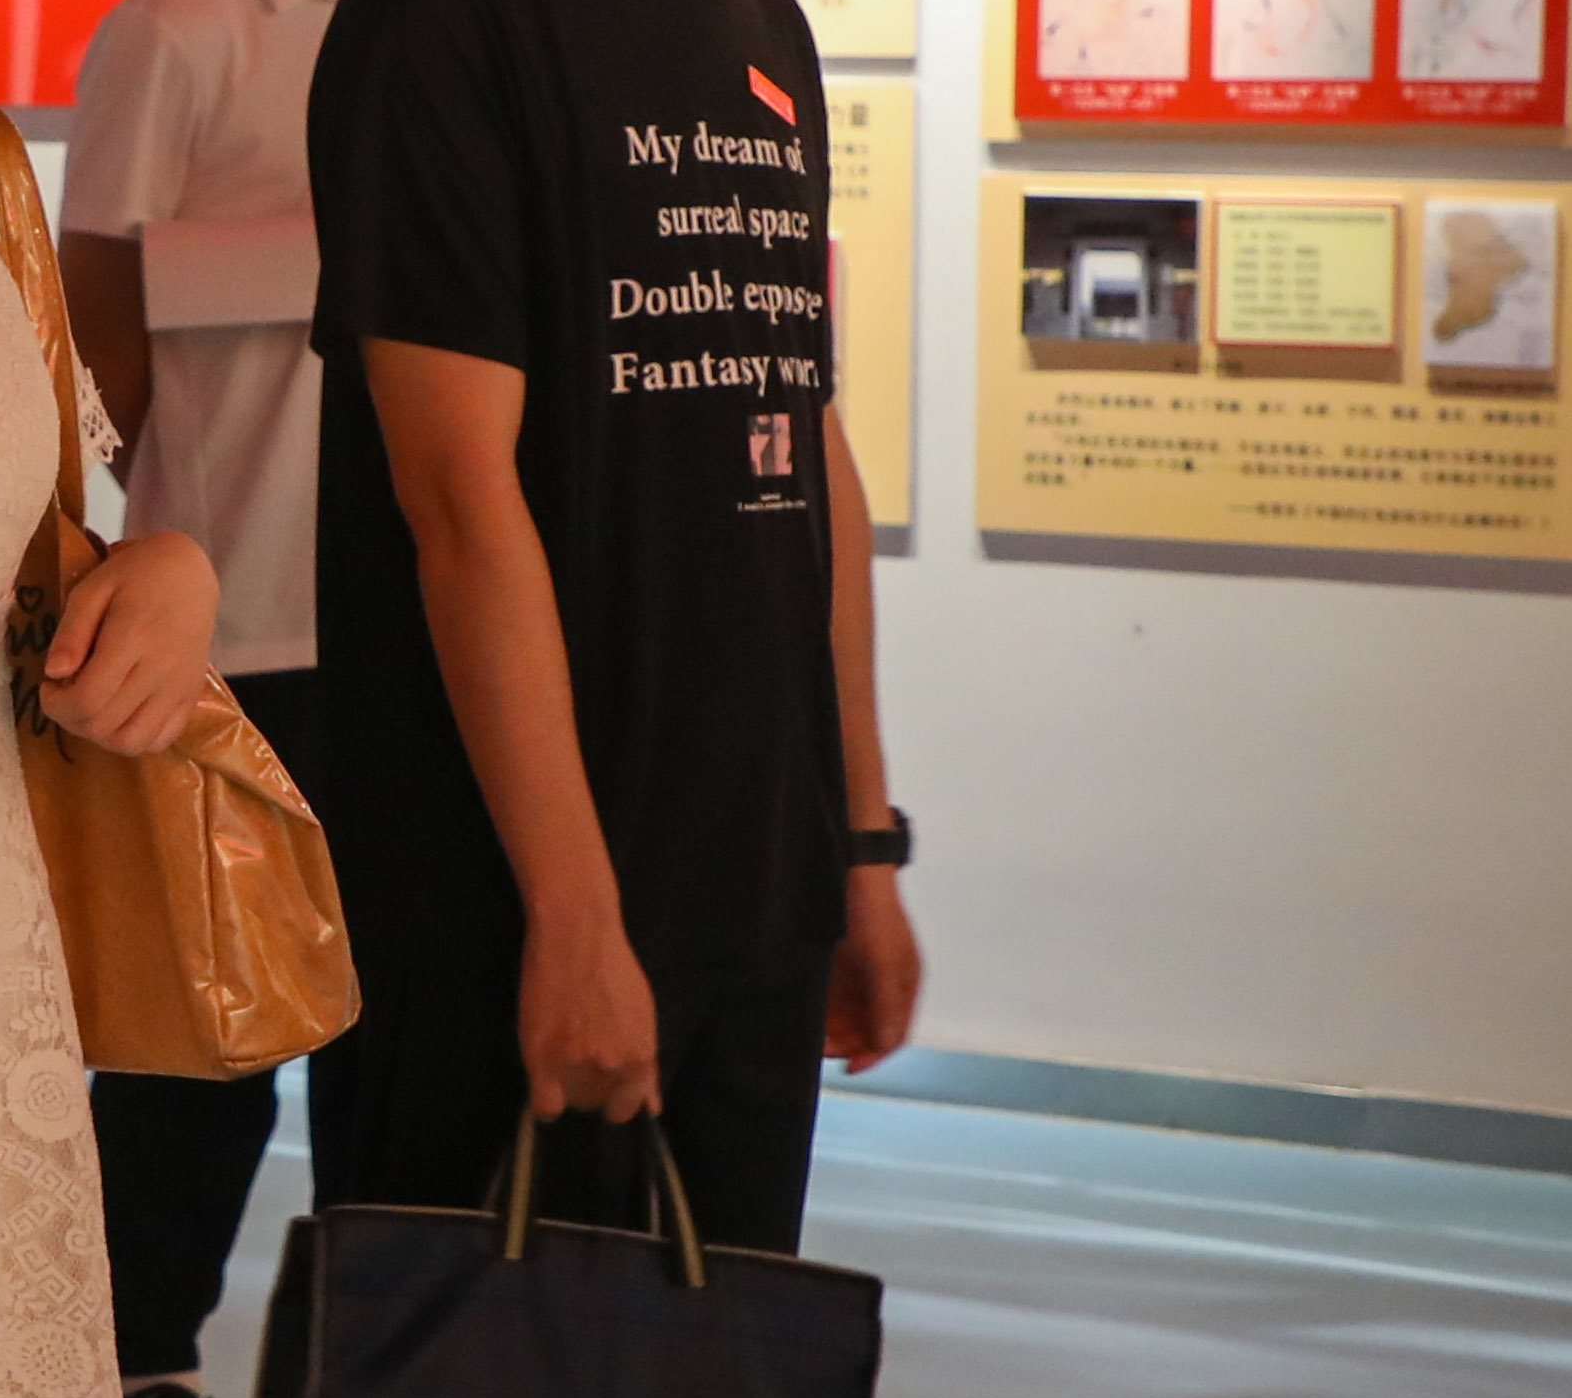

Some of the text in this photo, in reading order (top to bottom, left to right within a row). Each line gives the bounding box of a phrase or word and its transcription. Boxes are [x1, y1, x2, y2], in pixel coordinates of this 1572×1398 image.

[624, 124, 683, 175] My
[693, 120, 783, 169] dream
[657, 193, 810, 250] surreal space
[610, 269, 734, 320] Double
[610, 349, 772, 398] Fantasy
